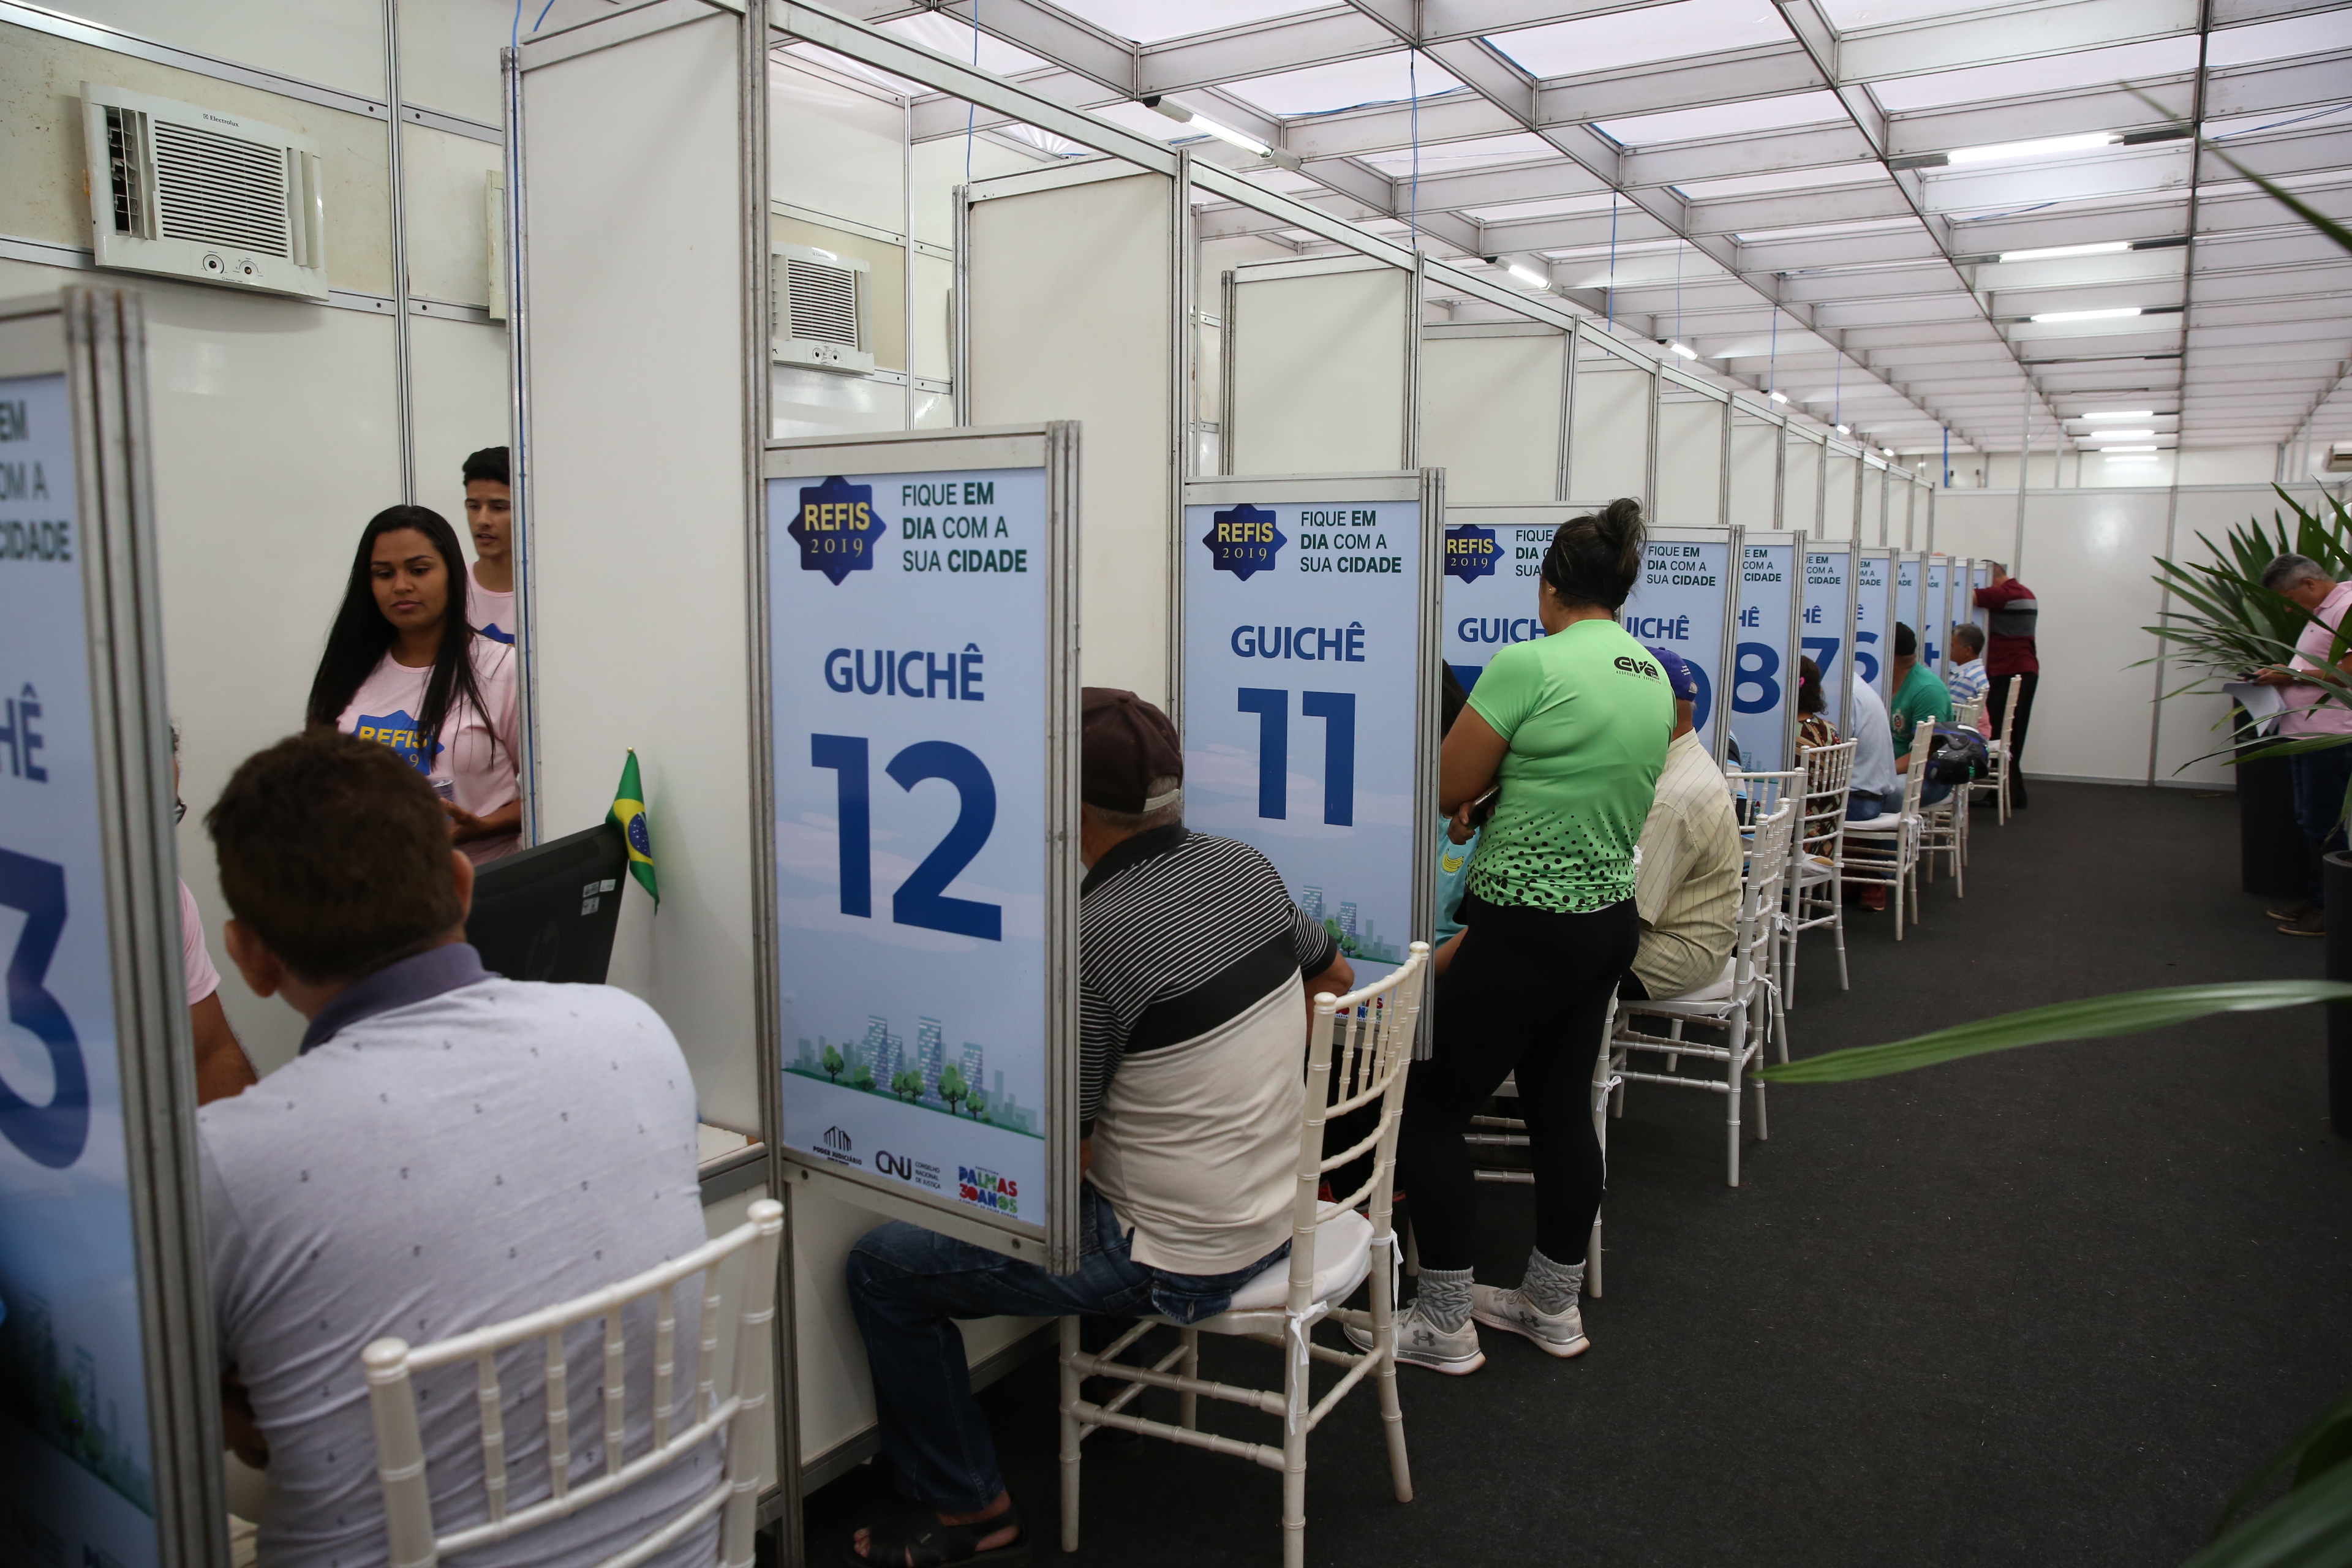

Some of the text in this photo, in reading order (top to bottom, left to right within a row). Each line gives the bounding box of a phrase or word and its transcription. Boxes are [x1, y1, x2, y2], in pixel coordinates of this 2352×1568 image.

[210, 115, 239, 127] Electrolux
[32, 461, 50, 500] A
[902, 482, 994, 507] FIQUE EM
[804, 502, 870, 531] REFIS
[1301, 510, 1376, 527] FIQUE EM
[903, 516, 1008, 539] DIA COM A
[1218, 522, 1274, 543] REFIS
[1516, 530, 1553, 542] FIQUE
[0, 519, 72, 561] IDADE
[811, 538, 863, 557] 2019
[1301, 534, 1387, 549] DIA COM A
[1447, 538, 1493, 554] REFIS
[903, 549, 1027, 572] SUA CIDADE
[1223, 548, 1267, 561] 2019
[1516, 548, 1539, 559] DIA
[1648, 546, 1700, 557] FIQUE EM
[1300, 557, 1401, 573] SUA CIDADE
[1451, 558, 1488, 568] 2019
[1516, 565, 1541, 576] SUA
[1648, 560, 1706, 571] DIA COM A
[1647, 575, 1716, 586] SUA CIDADE
[1458, 617, 1548, 643] GUICH
[1231, 621, 1365, 662] GUICHÊ
[824, 643, 984, 701] GUICHÊ
[1616, 670, 1641, 679] ASSESSORIA
[1732, 642, 1781, 714] 8
[359, 726, 428, 748] REFIS
[1238, 687, 1355, 826] 11
[811, 733, 1001, 941] 12
[0, 848, 89, 1169] 3
[959, 1166, 1017, 1197] PALMAS
